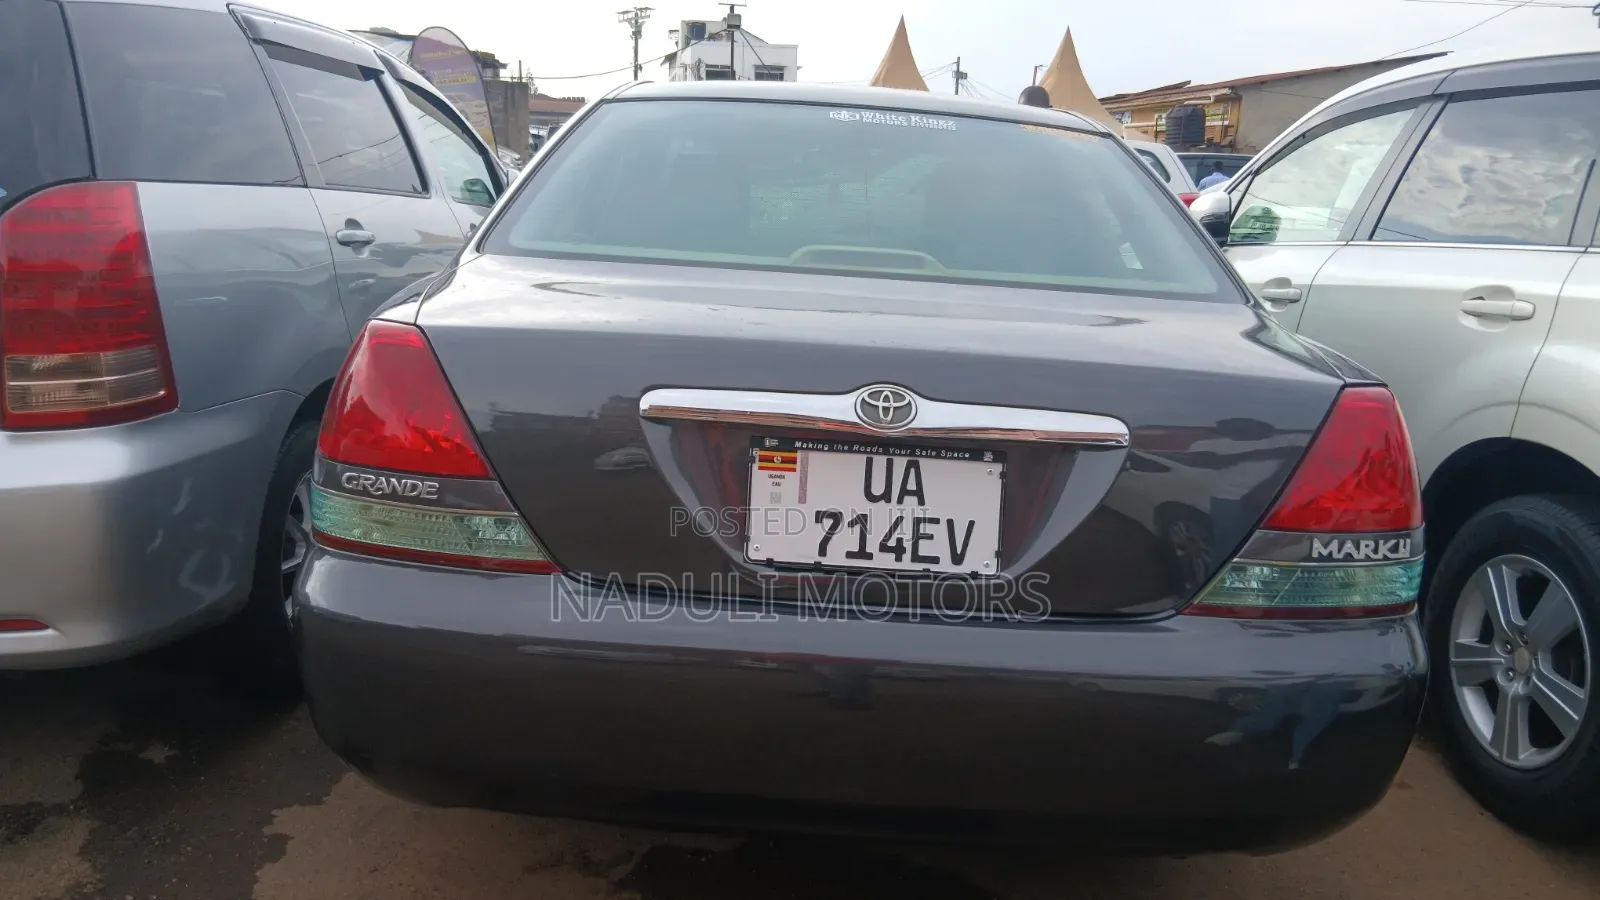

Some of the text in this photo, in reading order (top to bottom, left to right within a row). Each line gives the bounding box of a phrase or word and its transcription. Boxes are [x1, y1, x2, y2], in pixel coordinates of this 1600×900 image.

[861, 111, 905, 121] White
[909, 115, 956, 126] Kingz
[863, 118, 908, 126] MOTORS
[794, 441, 970, 459] Making the Roads Your Safe Space
[341, 472, 440, 500] GRANDE
[863, 456, 926, 506] UA
[814, 510, 975, 566] 714EV
